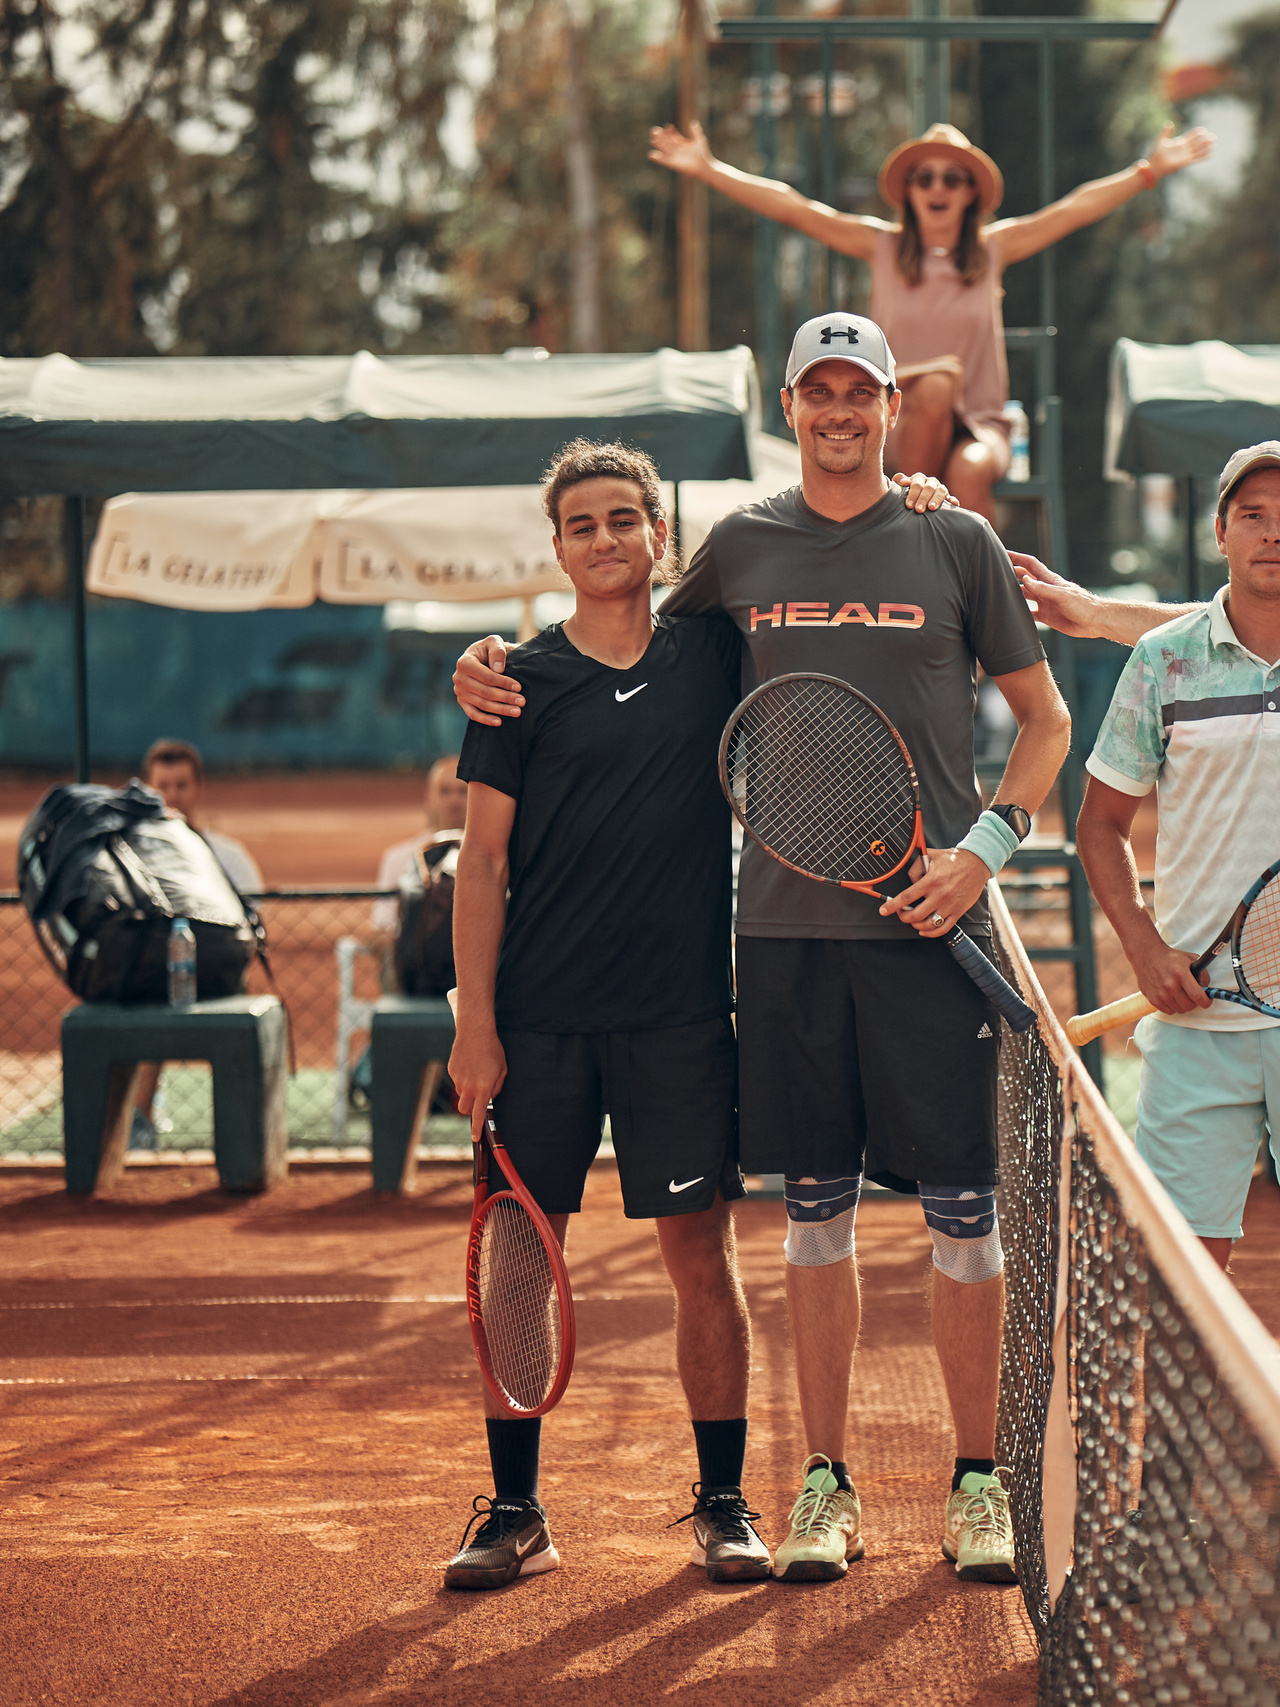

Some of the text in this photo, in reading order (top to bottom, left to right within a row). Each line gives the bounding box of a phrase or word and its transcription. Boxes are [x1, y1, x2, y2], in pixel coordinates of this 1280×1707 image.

[118, 545, 284, 591] LA GELATERI
[359, 553, 404, 584] LA
[750, 602, 925, 633] HEAD
